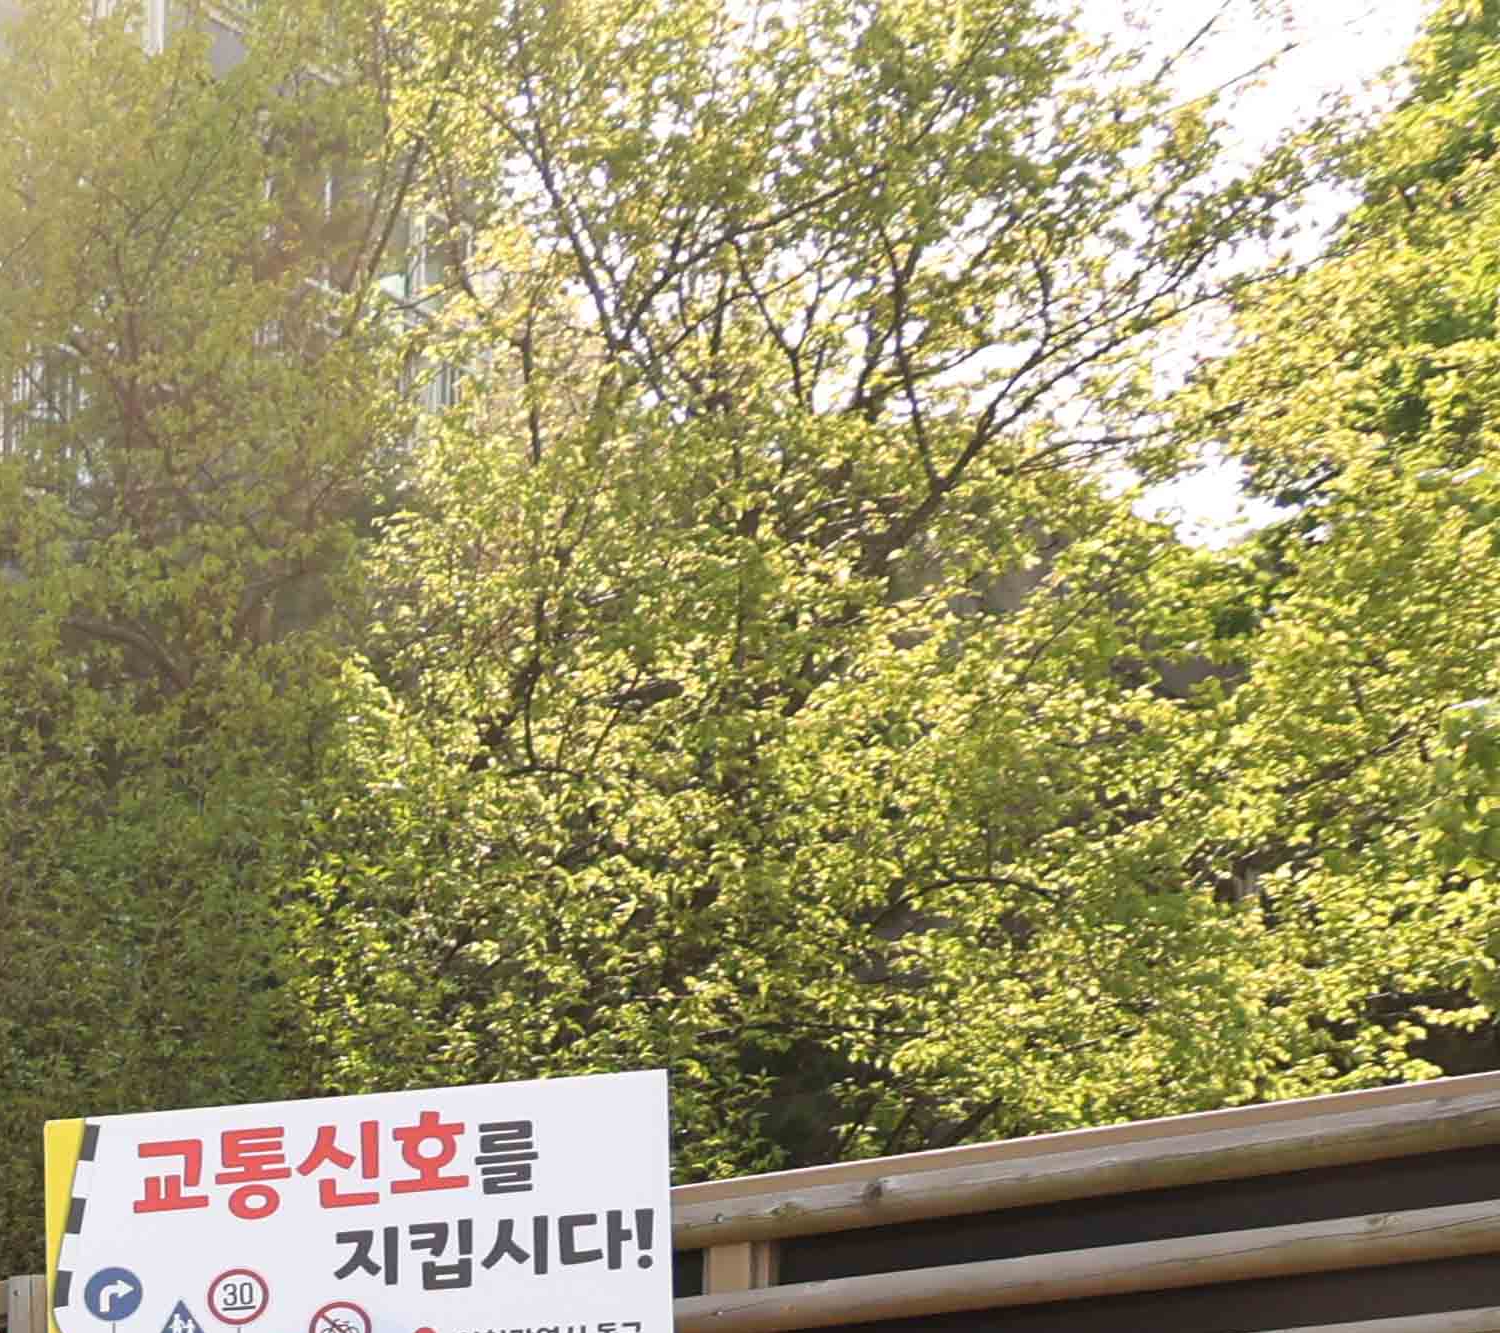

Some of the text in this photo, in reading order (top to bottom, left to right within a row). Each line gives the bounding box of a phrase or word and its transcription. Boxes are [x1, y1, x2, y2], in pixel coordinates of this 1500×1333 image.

[133, 1111, 539, 1220] 교통신호를
[335, 1207, 654, 1291] 지킵시다!
[223, 1283, 254, 1307] 30
